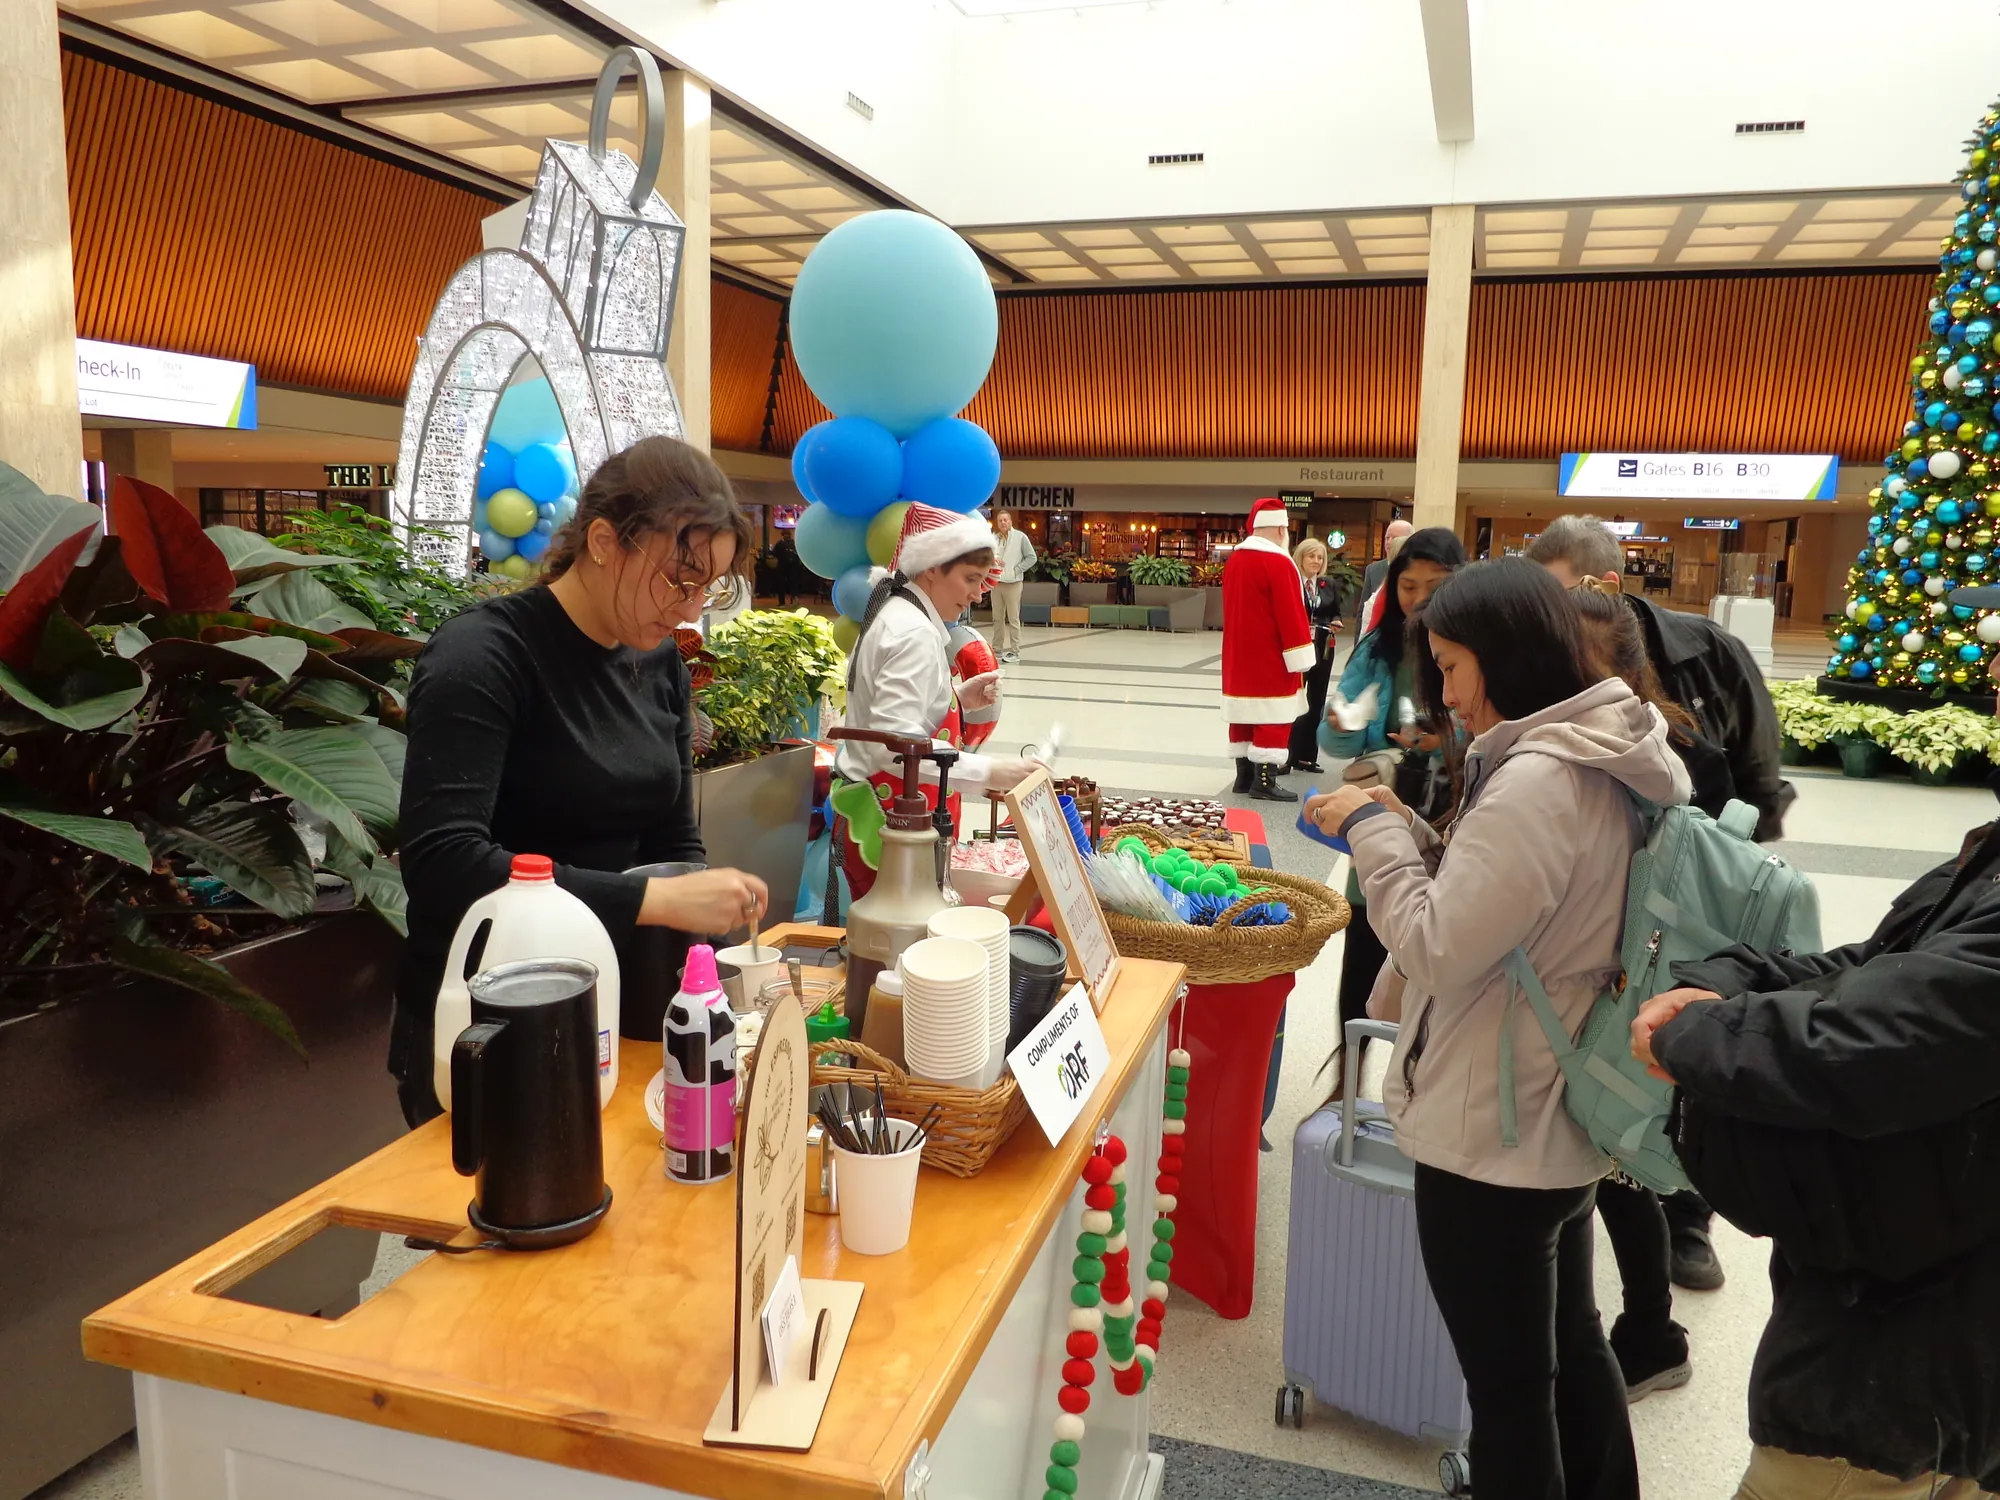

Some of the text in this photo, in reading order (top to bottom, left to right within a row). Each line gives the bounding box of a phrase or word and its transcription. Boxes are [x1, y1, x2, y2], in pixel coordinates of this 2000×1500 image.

[78, 355, 141, 381] heck-In
[324, 465, 373, 487] THE
[1300, 467, 1385, 481] Restaurant
[1643, 461, 1771, 478] Gates B16 B30
[1001, 486, 1075, 508] KITCHEN
[1294, 495, 1313, 503] LOCAL
[1105, 534, 1145, 545] ROVISIONS
[889, 818, 908, 827] ONIN
[1027, 1002, 1079, 1067] COMPLIMENTS OF
[1057, 1039, 1090, 1101] ORF
